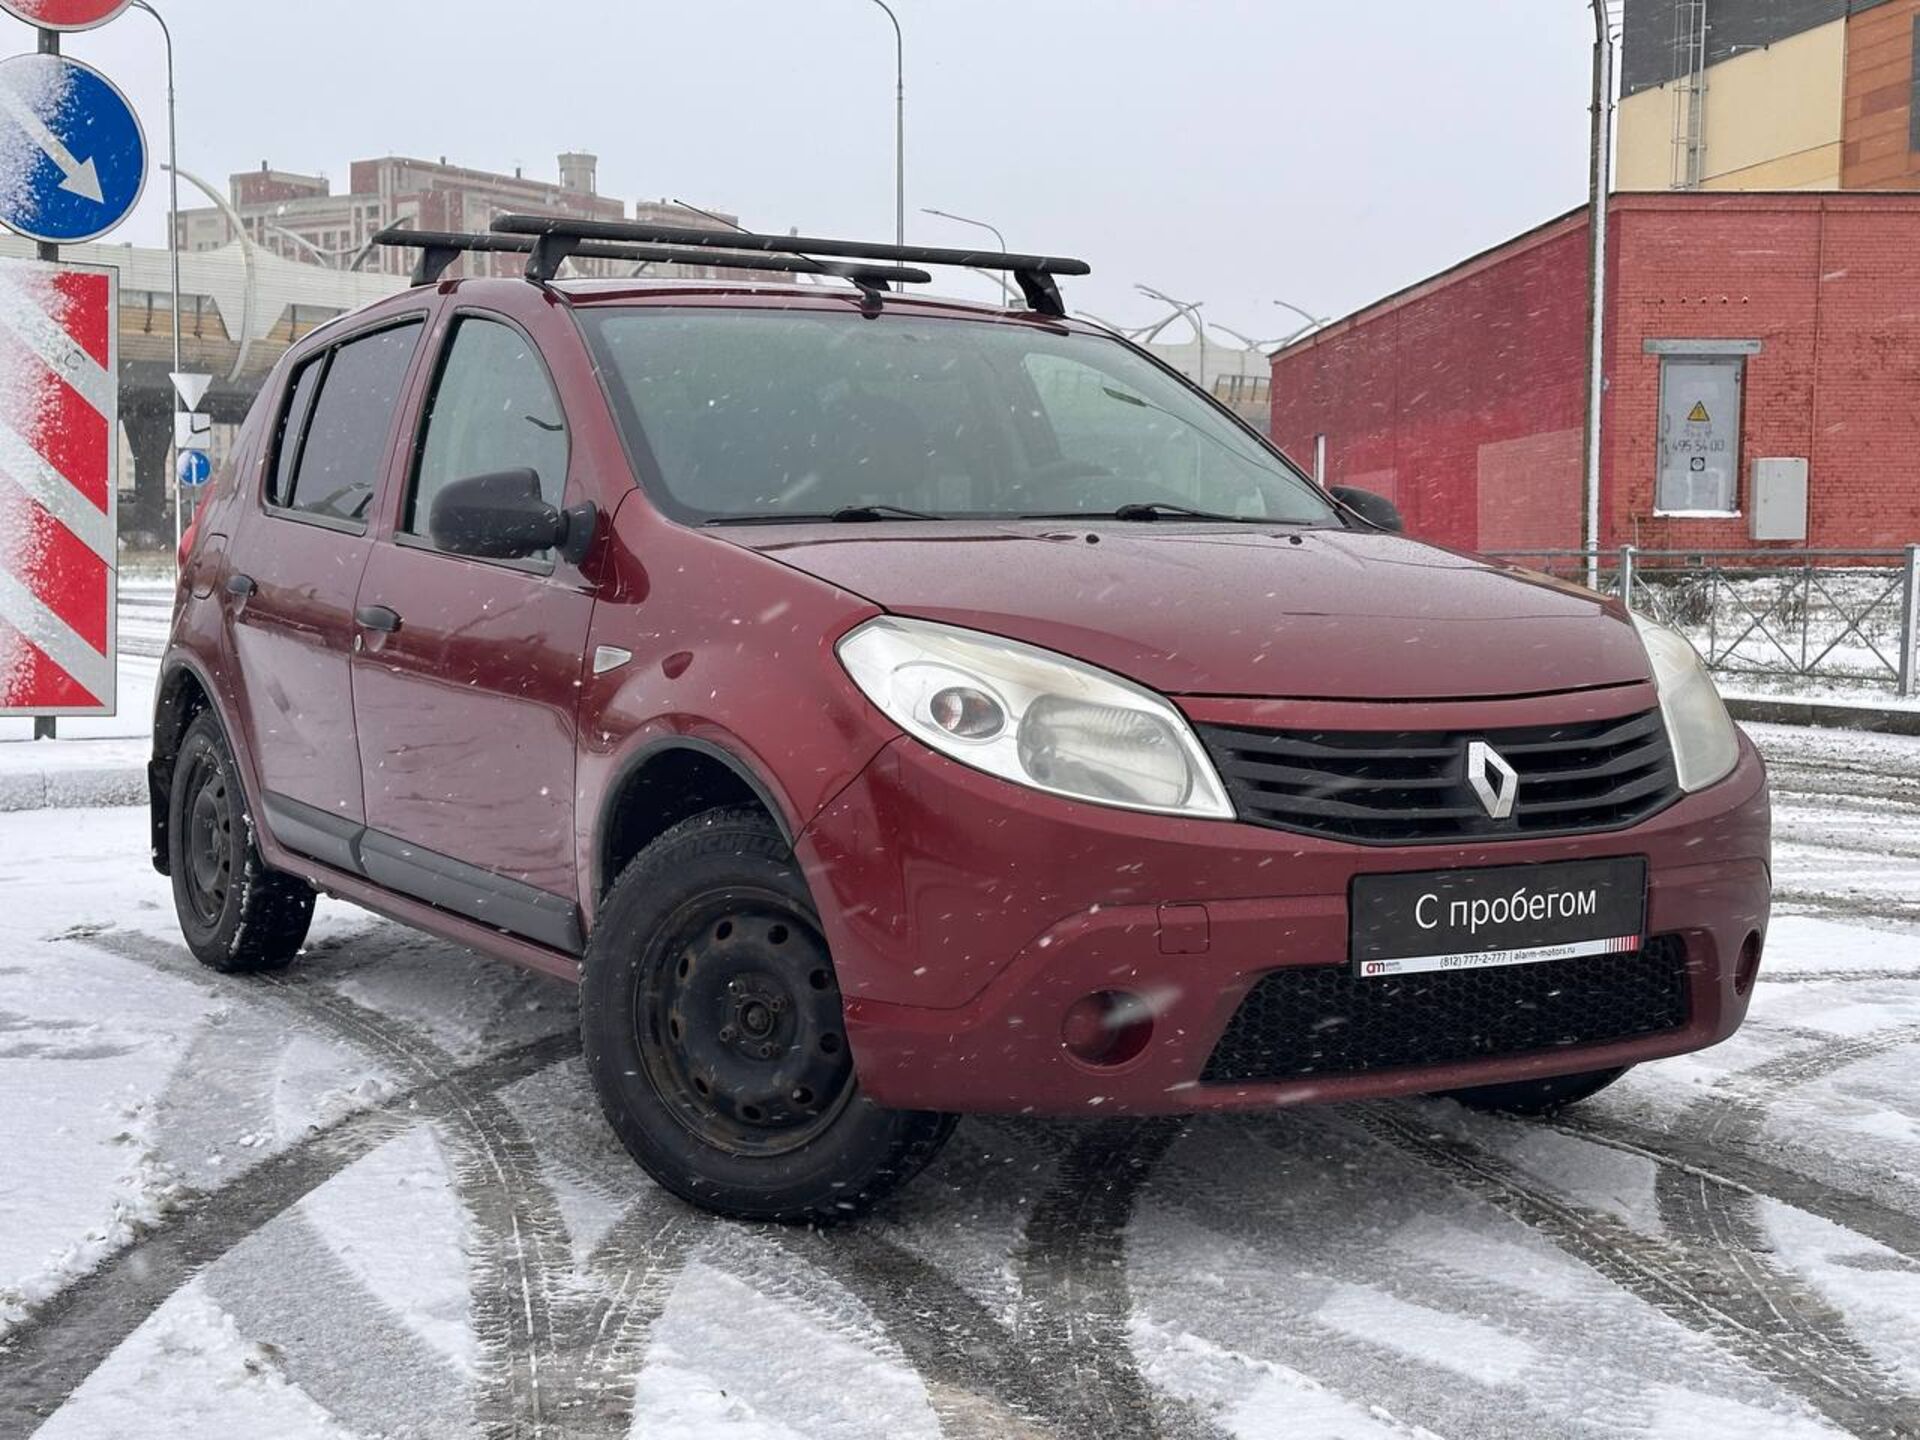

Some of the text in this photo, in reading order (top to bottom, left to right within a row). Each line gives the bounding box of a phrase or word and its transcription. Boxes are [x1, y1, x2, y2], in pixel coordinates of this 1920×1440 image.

[1415, 887, 1597, 934] С пробегом
[1439, 946, 1576, 968] (812) 777-2-777 alarm-motors.ru
